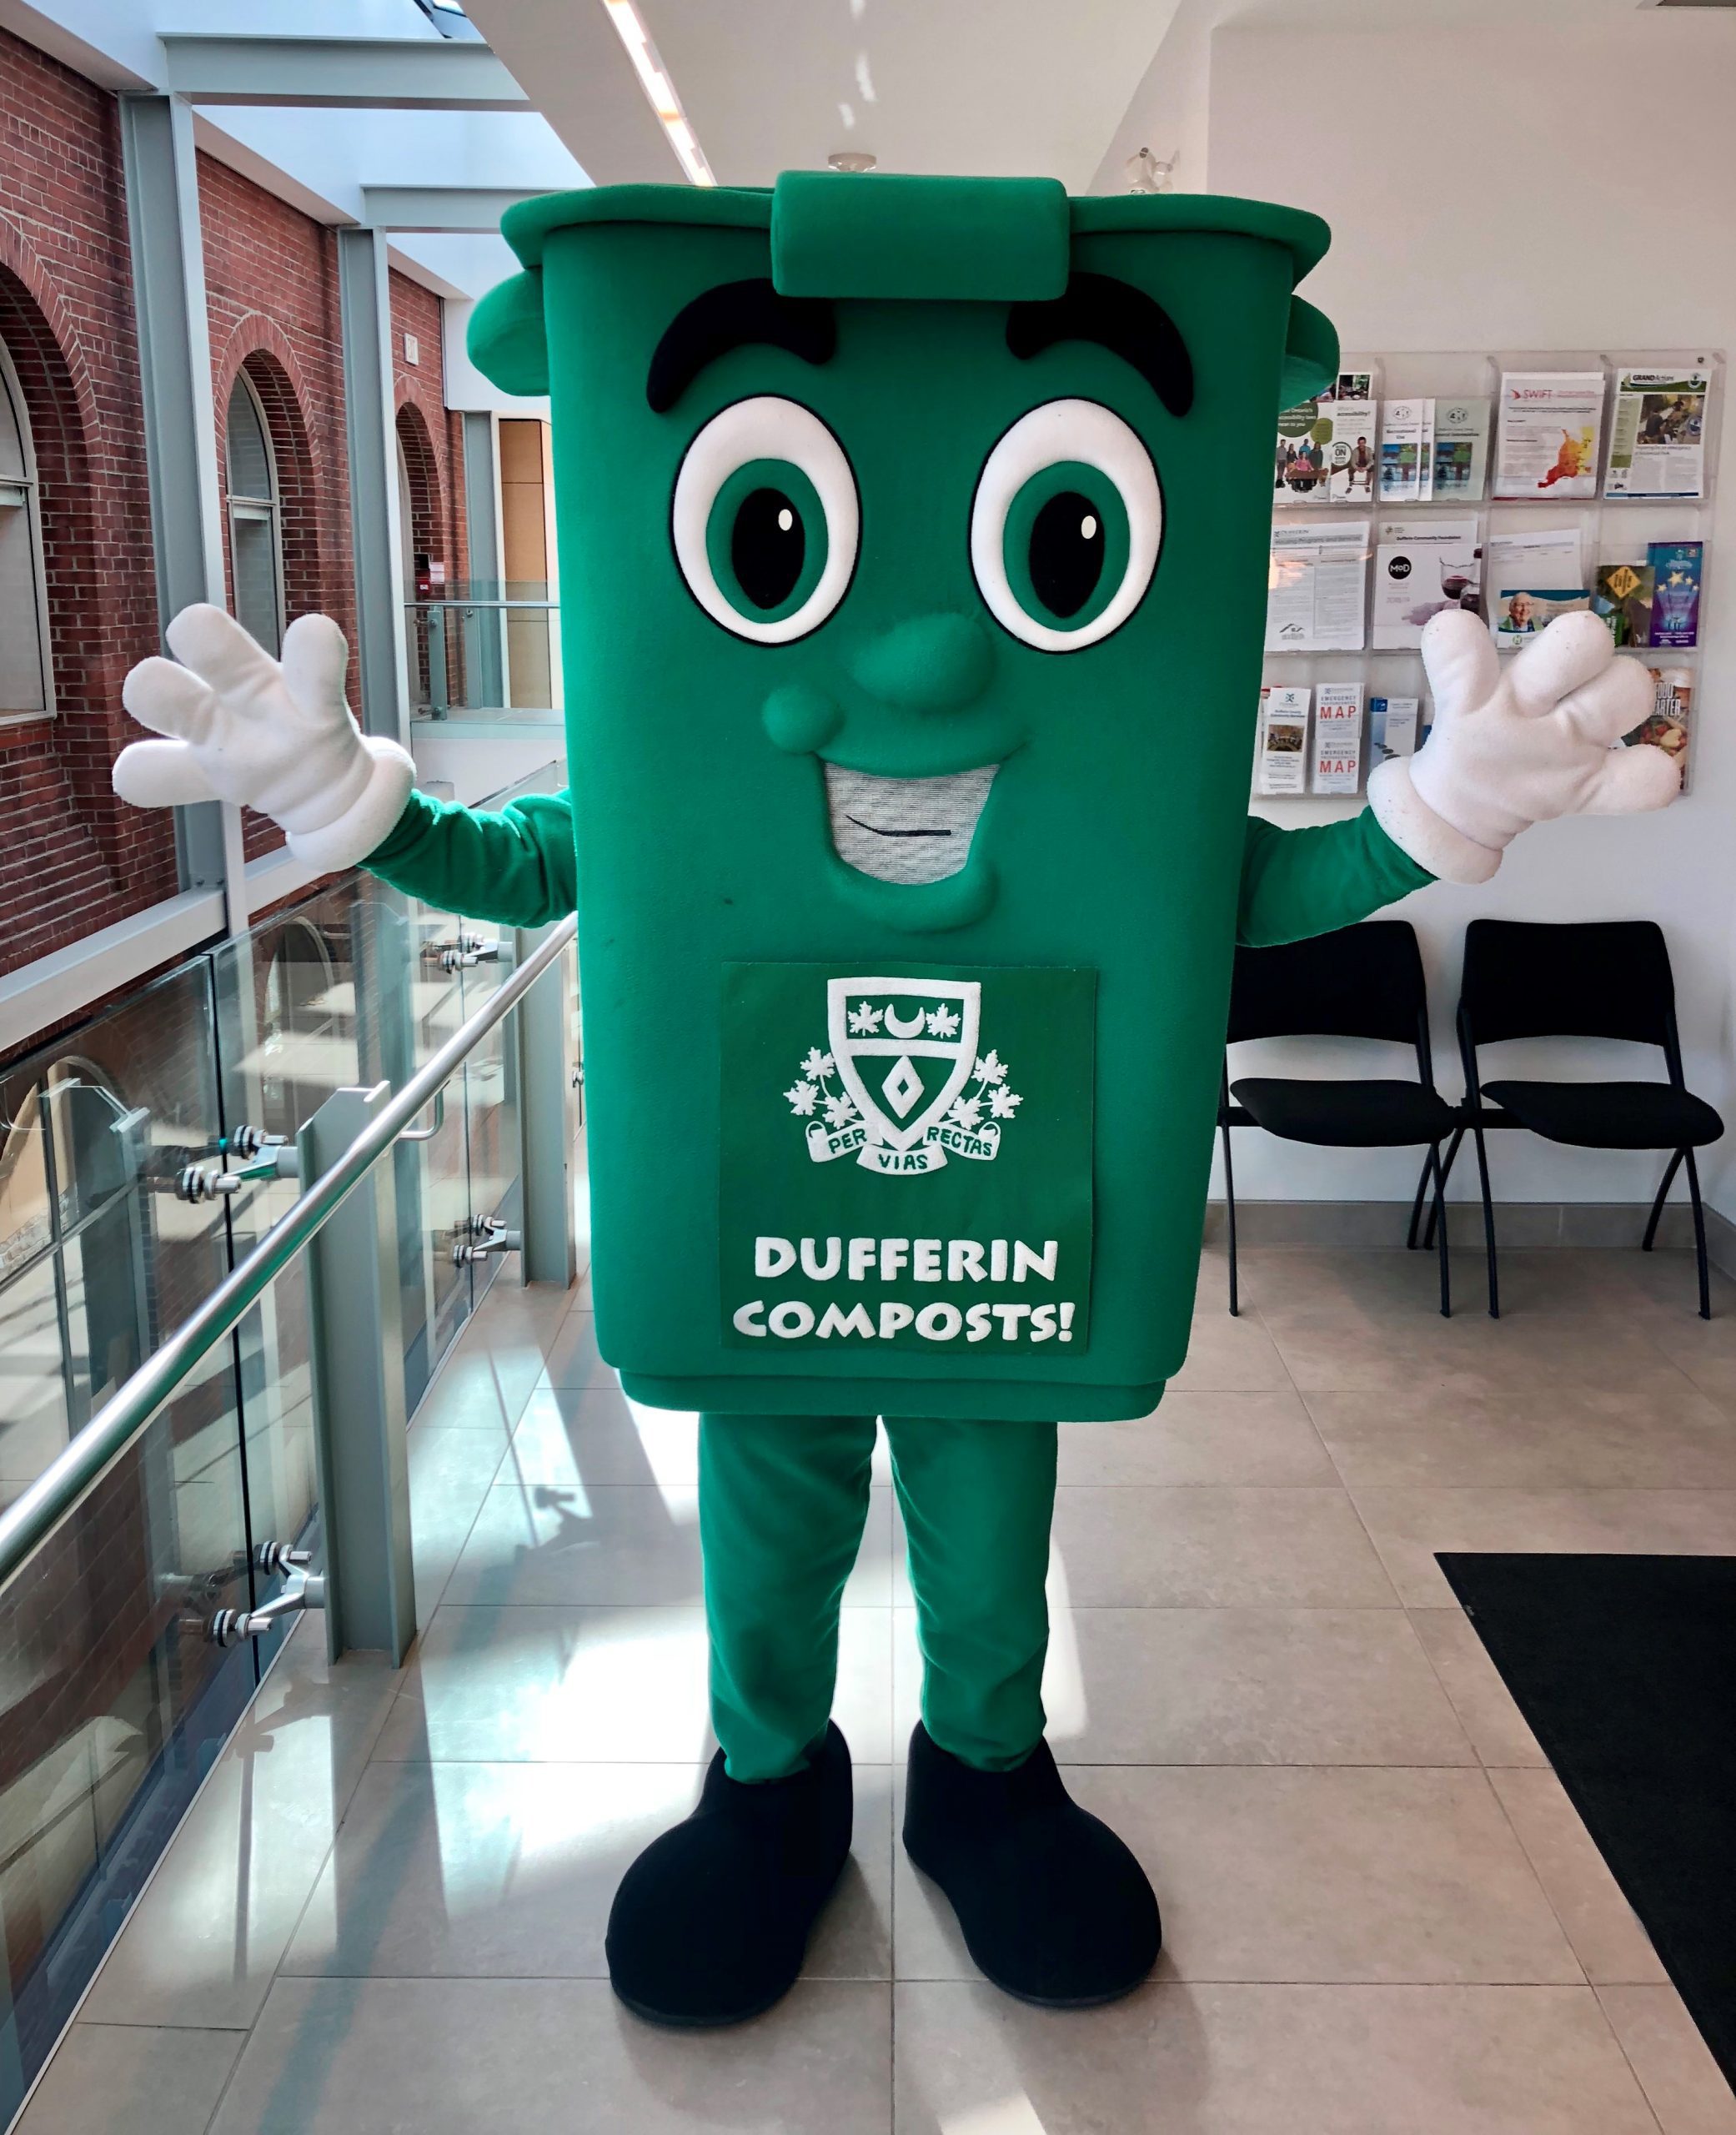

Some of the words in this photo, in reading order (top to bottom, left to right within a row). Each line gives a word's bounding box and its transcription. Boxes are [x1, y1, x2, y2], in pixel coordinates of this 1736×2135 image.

[1523, 389, 1553, 399] SWIFT
[1320, 706, 1357, 719] MAP
[1320, 760, 1357, 773] MAP
[828, 1128, 868, 1155] PER
[879, 1153, 928, 1171] VIAS
[926, 1126, 993, 1157] RECTAS
[755, 1236, 1058, 1283] DUFFERIN
[733, 1299, 1076, 1343] COMPOSTS!
